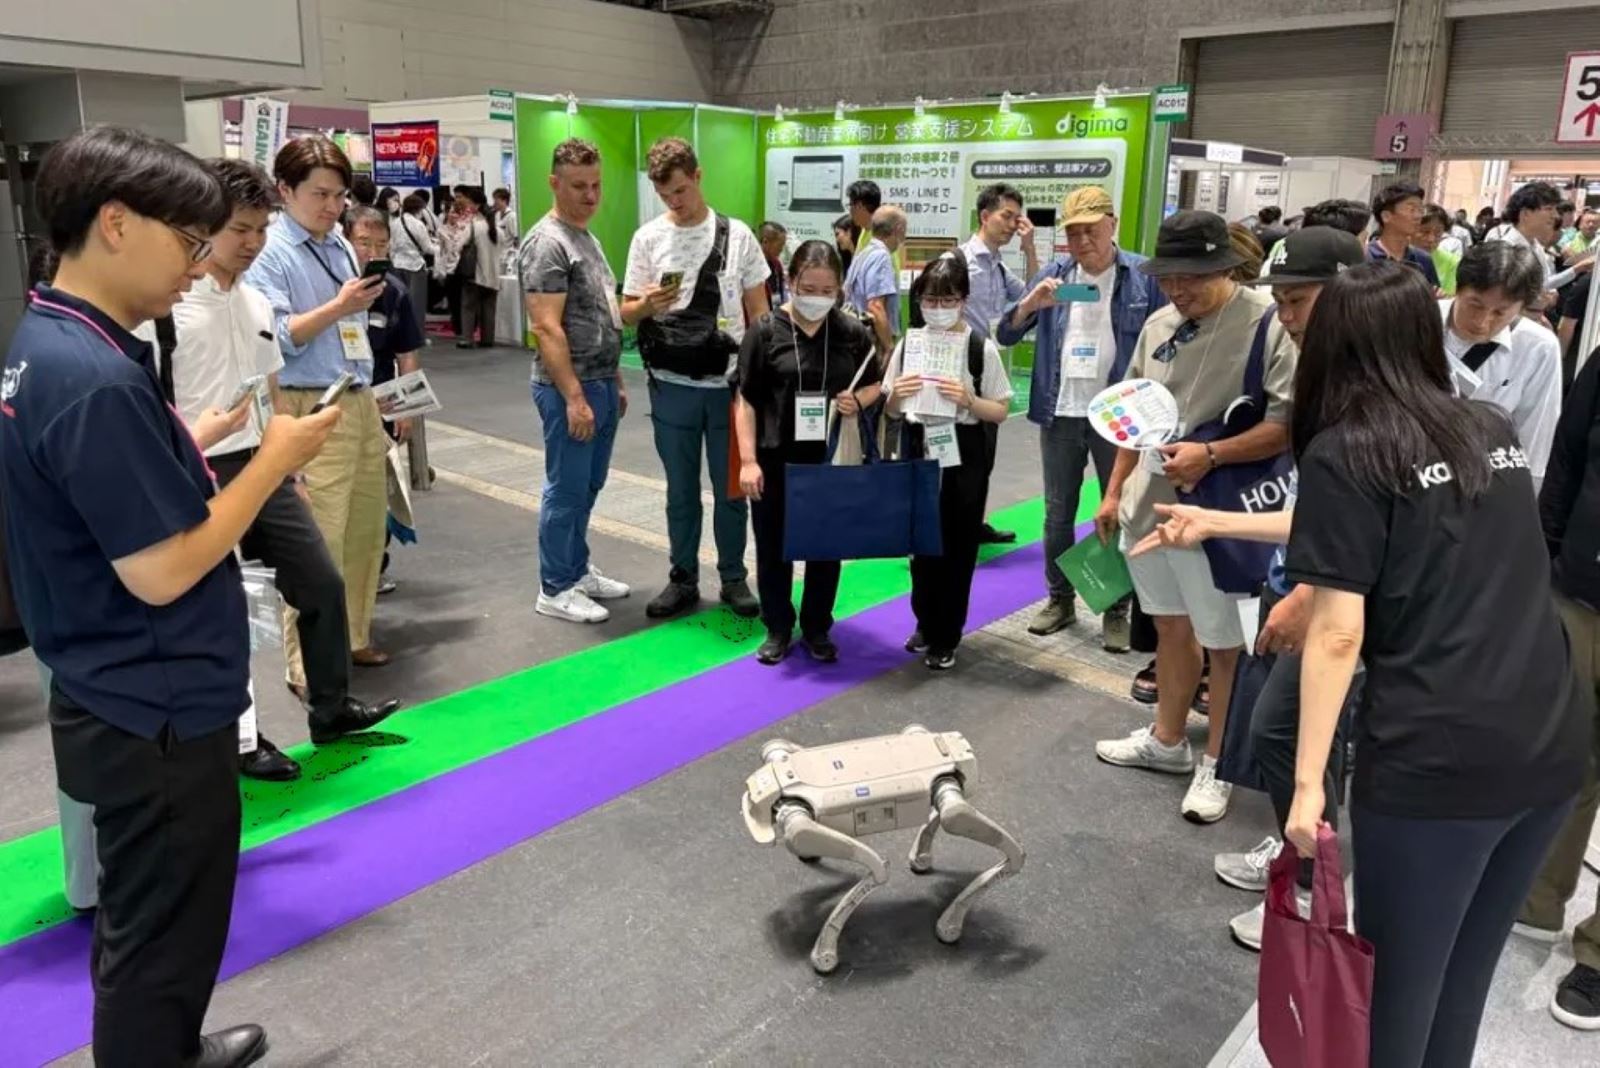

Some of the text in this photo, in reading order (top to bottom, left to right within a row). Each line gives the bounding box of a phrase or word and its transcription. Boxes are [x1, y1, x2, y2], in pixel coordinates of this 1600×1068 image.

[1577, 65, 1600, 101] 5
[1157, 98, 1186, 108] AC012
[1056, 111, 1128, 138] digima
[1391, 135, 1406, 152] 5
[1240, 471, 1293, 513] HOU
